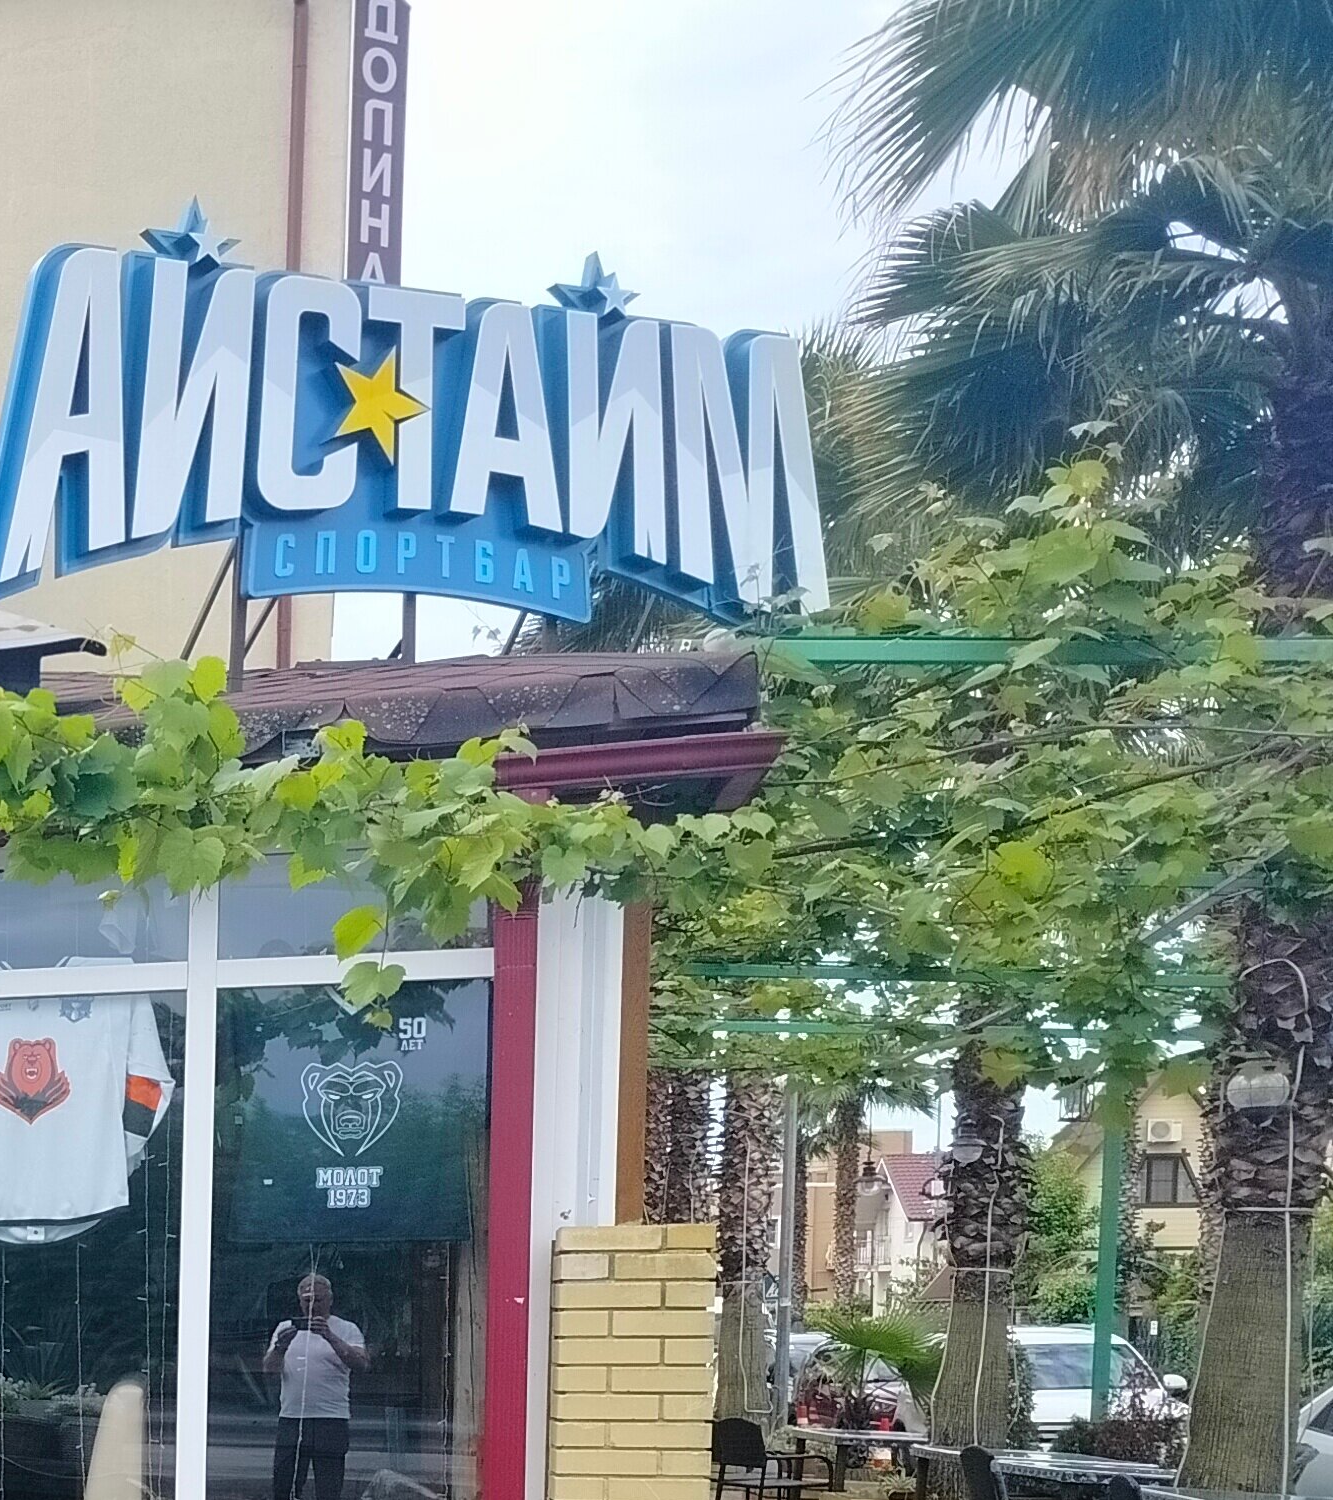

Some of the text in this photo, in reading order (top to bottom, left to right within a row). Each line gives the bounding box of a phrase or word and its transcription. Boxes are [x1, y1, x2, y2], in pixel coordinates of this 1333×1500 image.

[274, 529, 571, 600] СПОРТБАР
[399, 1017, 426, 1039] 50
[401, 1040, 423, 1050] ЛЕТ
[317, 1167, 383, 1187] МОЛОТ
[328, 1188, 371, 1207] 1973
